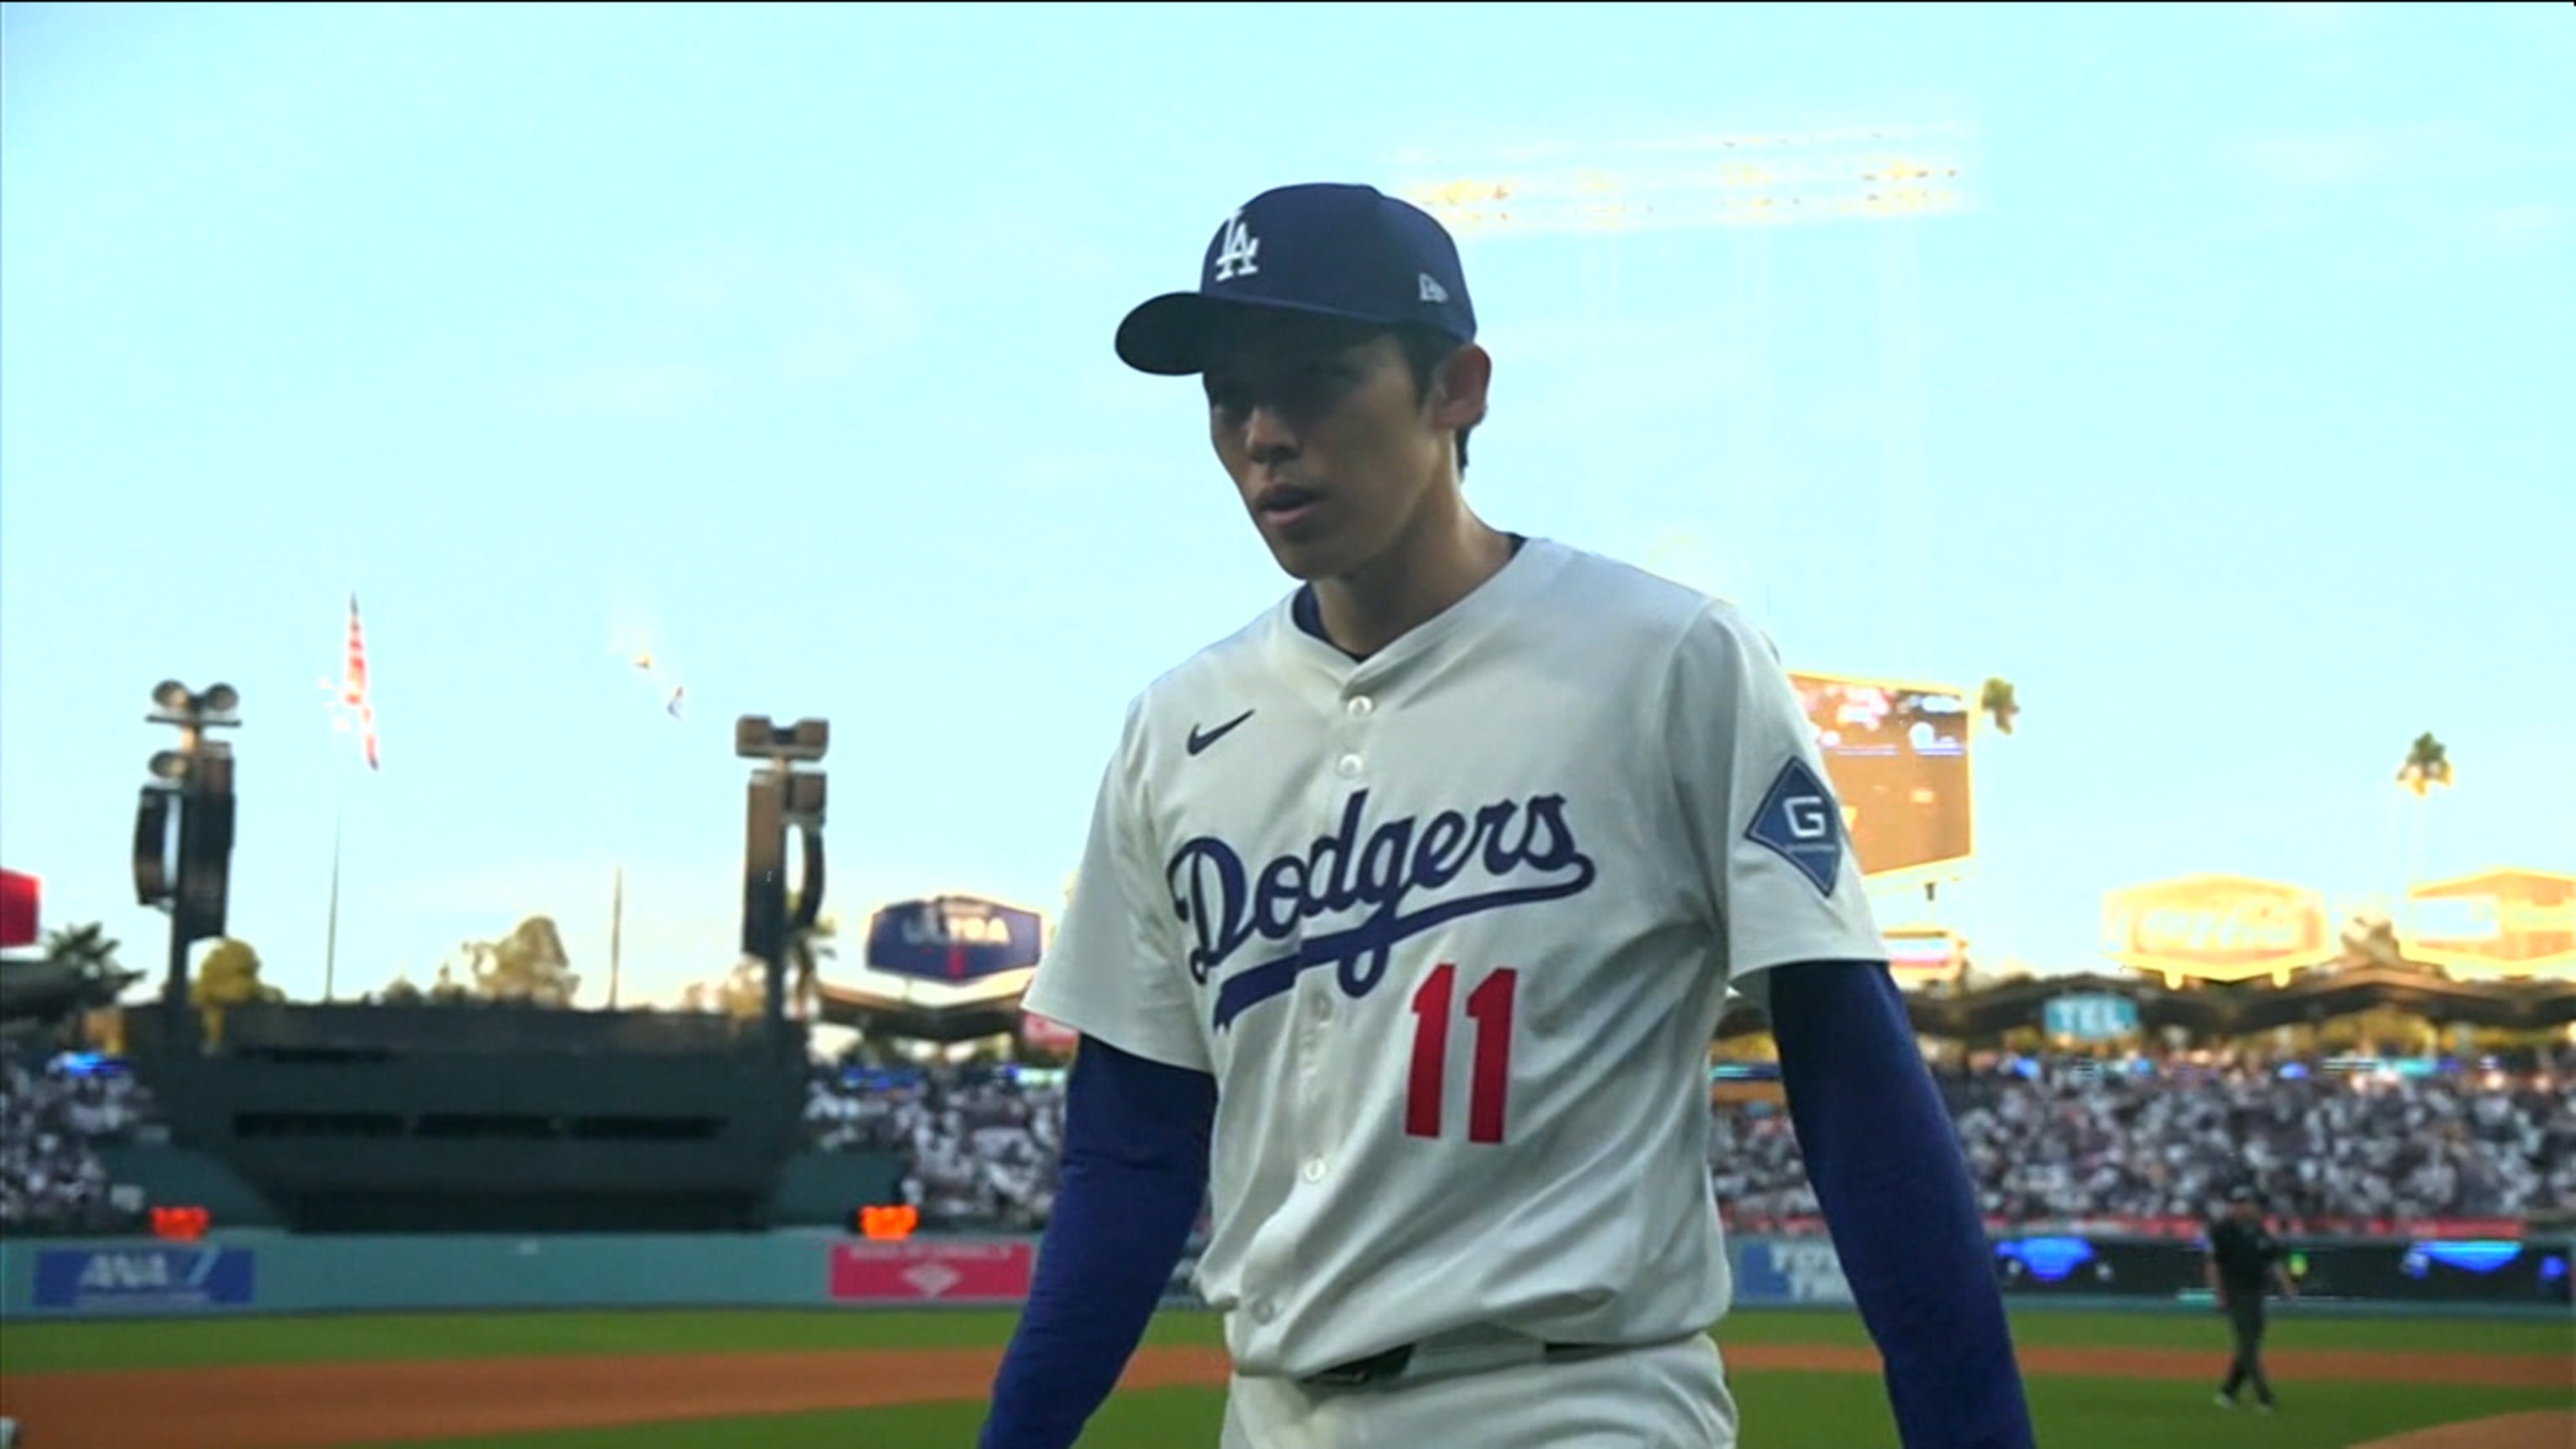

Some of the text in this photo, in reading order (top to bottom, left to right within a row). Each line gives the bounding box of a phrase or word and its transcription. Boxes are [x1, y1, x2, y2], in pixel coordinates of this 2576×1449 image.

[1215, 208, 1260, 282] LA
[1783, 795, 1827, 839] G
[1166, 788, 1597, 1000] Dodgers
[1405, 963, 1518, 1145] 11
